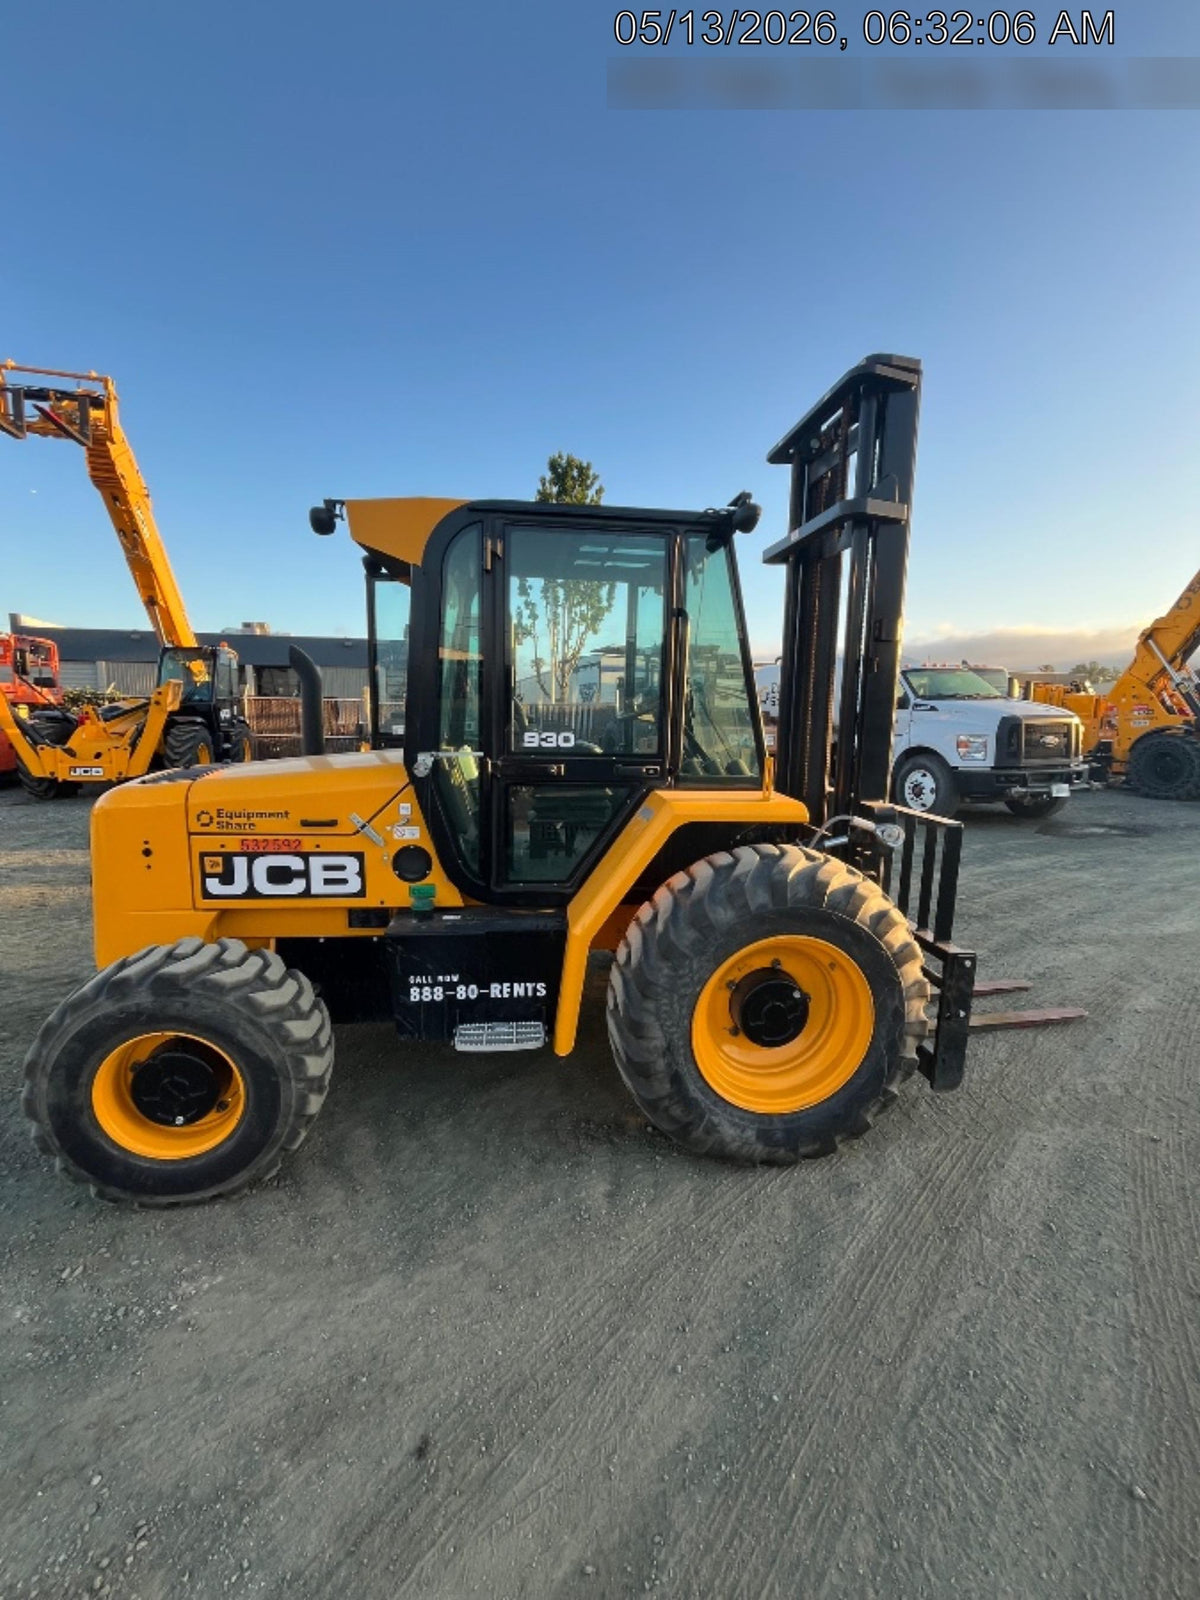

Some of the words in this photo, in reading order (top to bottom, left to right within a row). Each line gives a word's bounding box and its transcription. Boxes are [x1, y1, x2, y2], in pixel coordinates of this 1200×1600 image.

[523, 732, 575, 747] 930
[216, 808, 290, 820] Equipment
[216, 820, 256, 830] Share
[240, 838, 302, 851] 532592
[205, 855, 362, 895] JCB
[408, 975, 433, 984] CALL
[437, 974, 460, 982] NOW
[410, 983, 547, 1001] 888-80-RENTS
